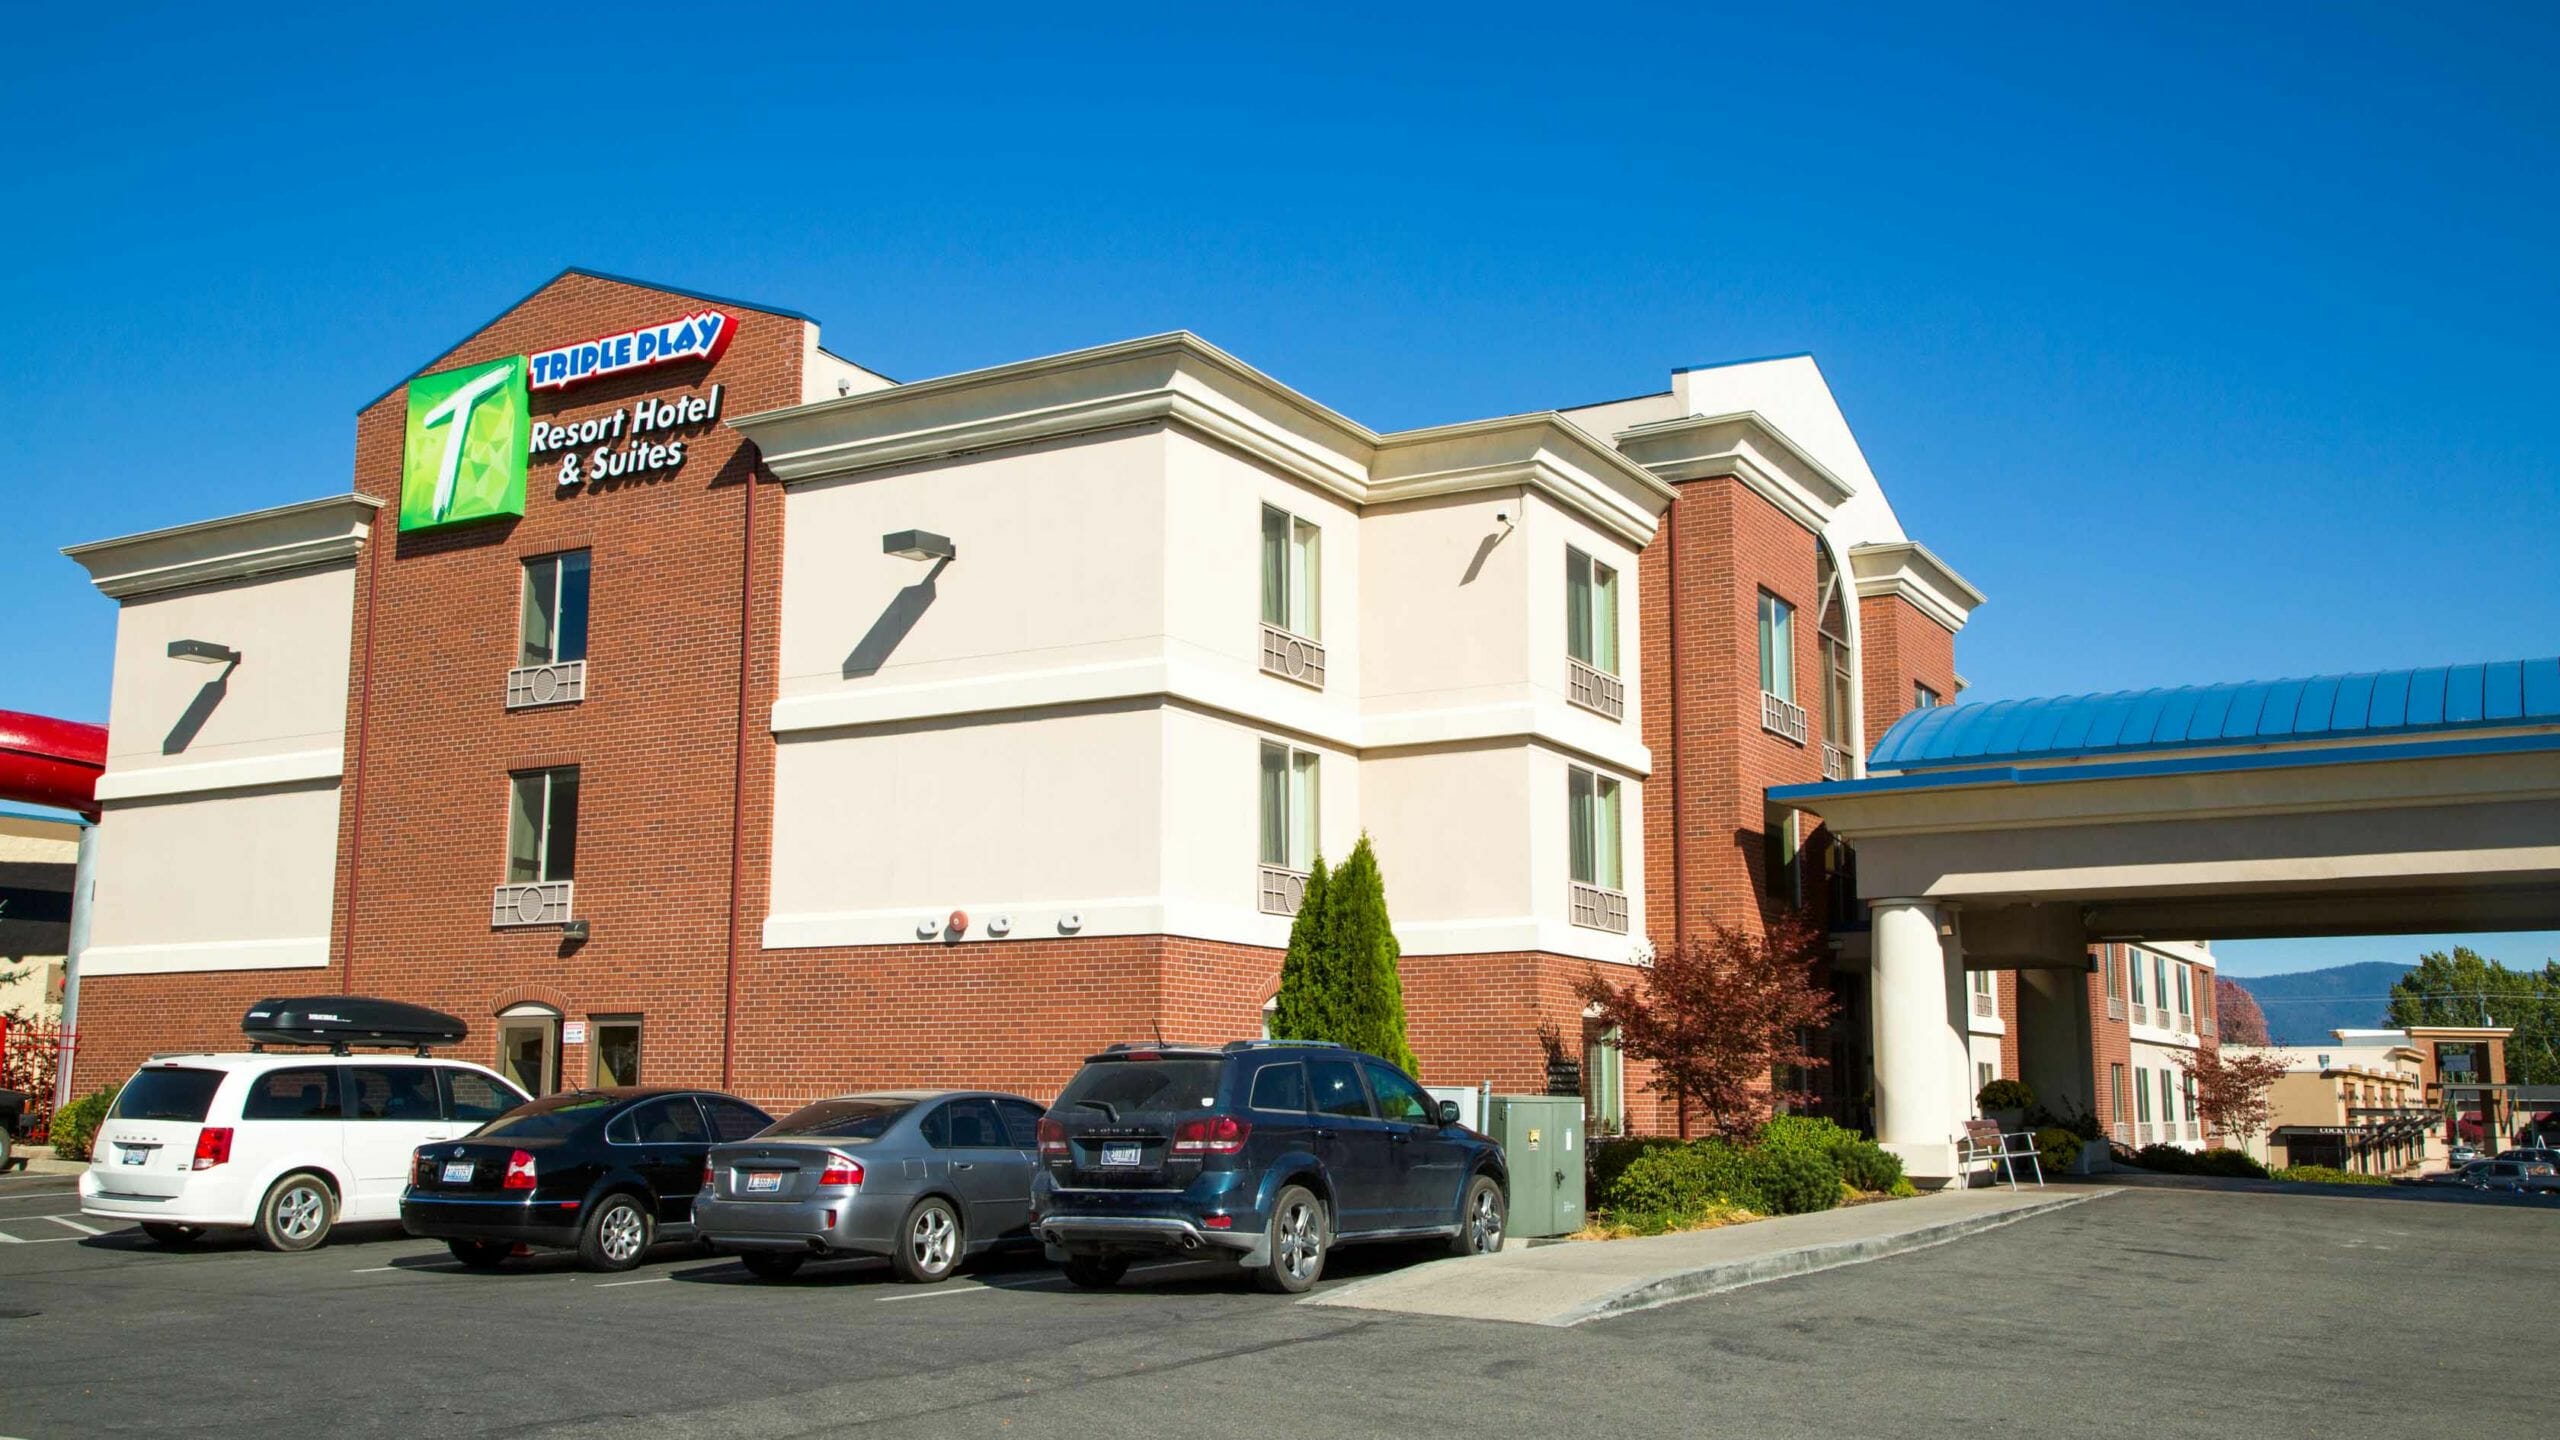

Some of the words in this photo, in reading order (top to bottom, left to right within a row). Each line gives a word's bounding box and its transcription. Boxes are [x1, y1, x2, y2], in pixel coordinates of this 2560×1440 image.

[533, 336, 632, 384] TRIPLE
[637, 315, 721, 361] PLAY
[423, 364, 516, 523] T
[529, 408, 626, 454] Resort
[632, 383, 720, 434] Hotel
[558, 453, 581, 486] &
[590, 440, 683, 480] Suites
